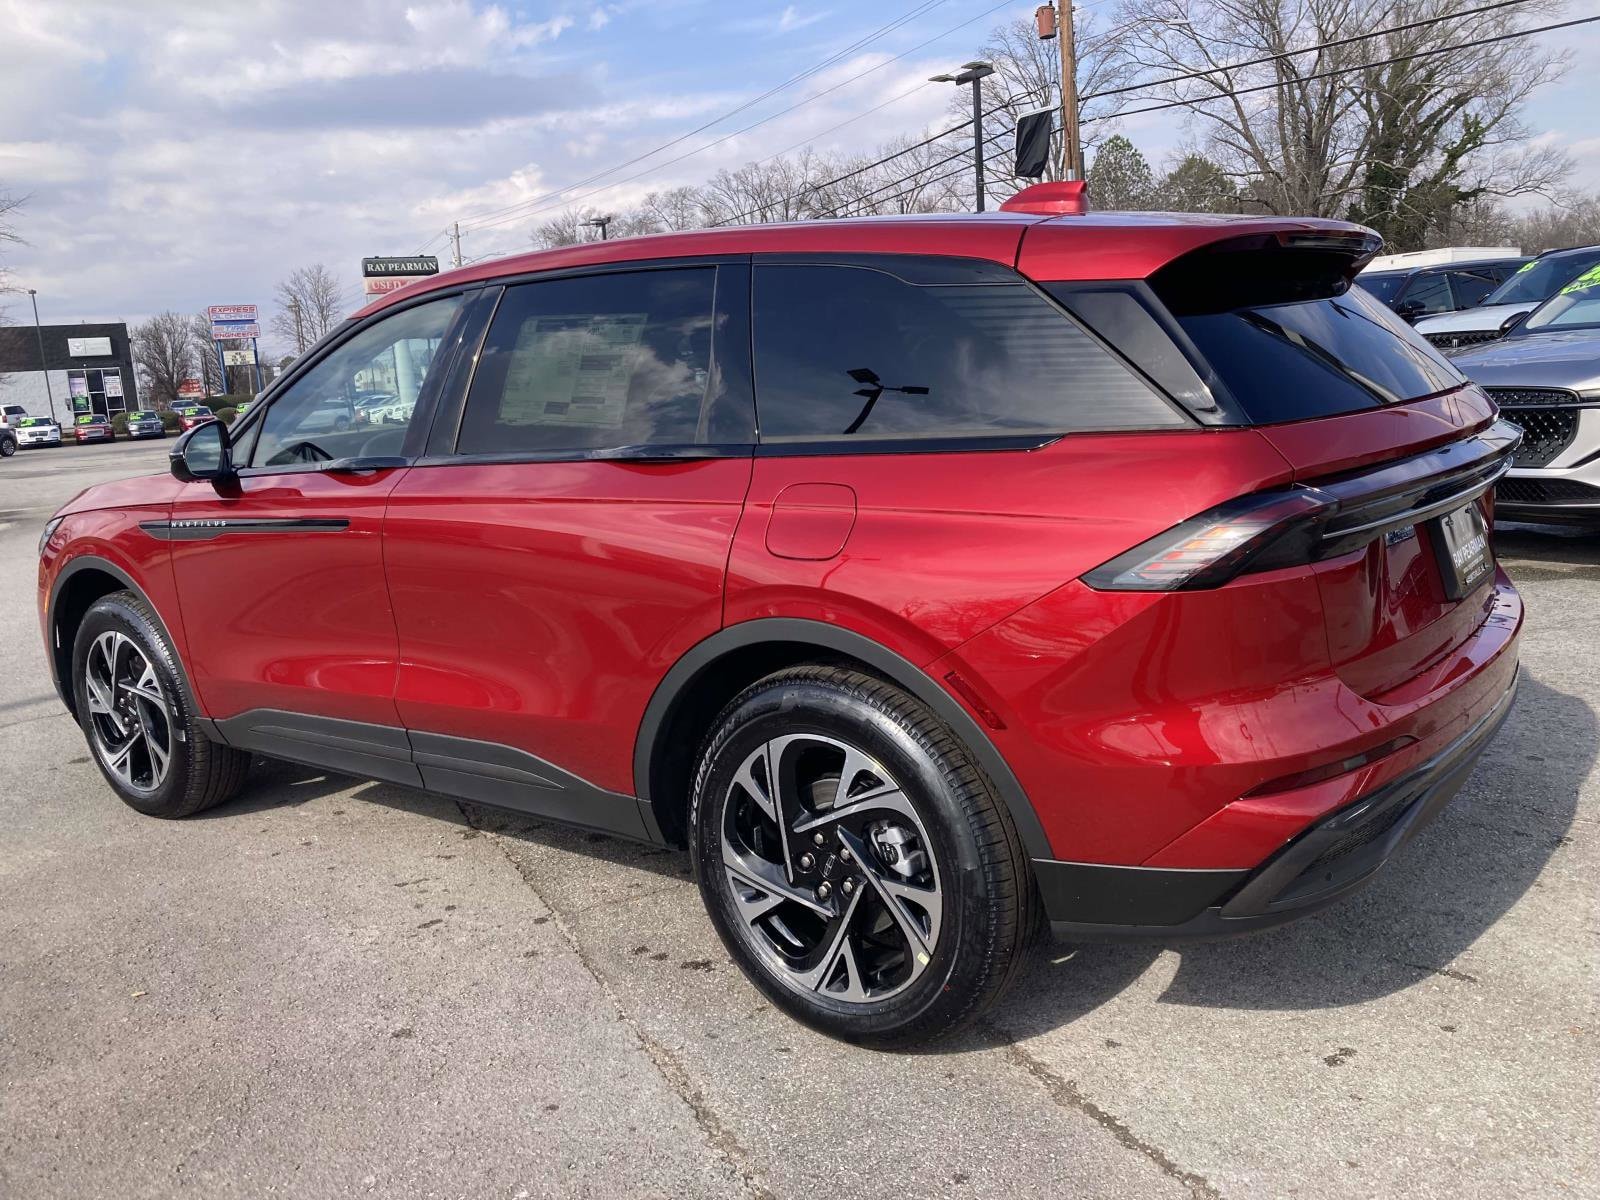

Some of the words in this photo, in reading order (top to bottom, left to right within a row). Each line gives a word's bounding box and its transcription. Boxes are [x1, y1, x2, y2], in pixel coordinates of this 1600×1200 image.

[367, 263, 386, 272] RAY
[388, 262, 437, 271] PEARMAN
[371, 281, 401, 290] USED
[171, 520, 227, 528] NAUTILUS
[691, 718, 735, 825] SCORPION
